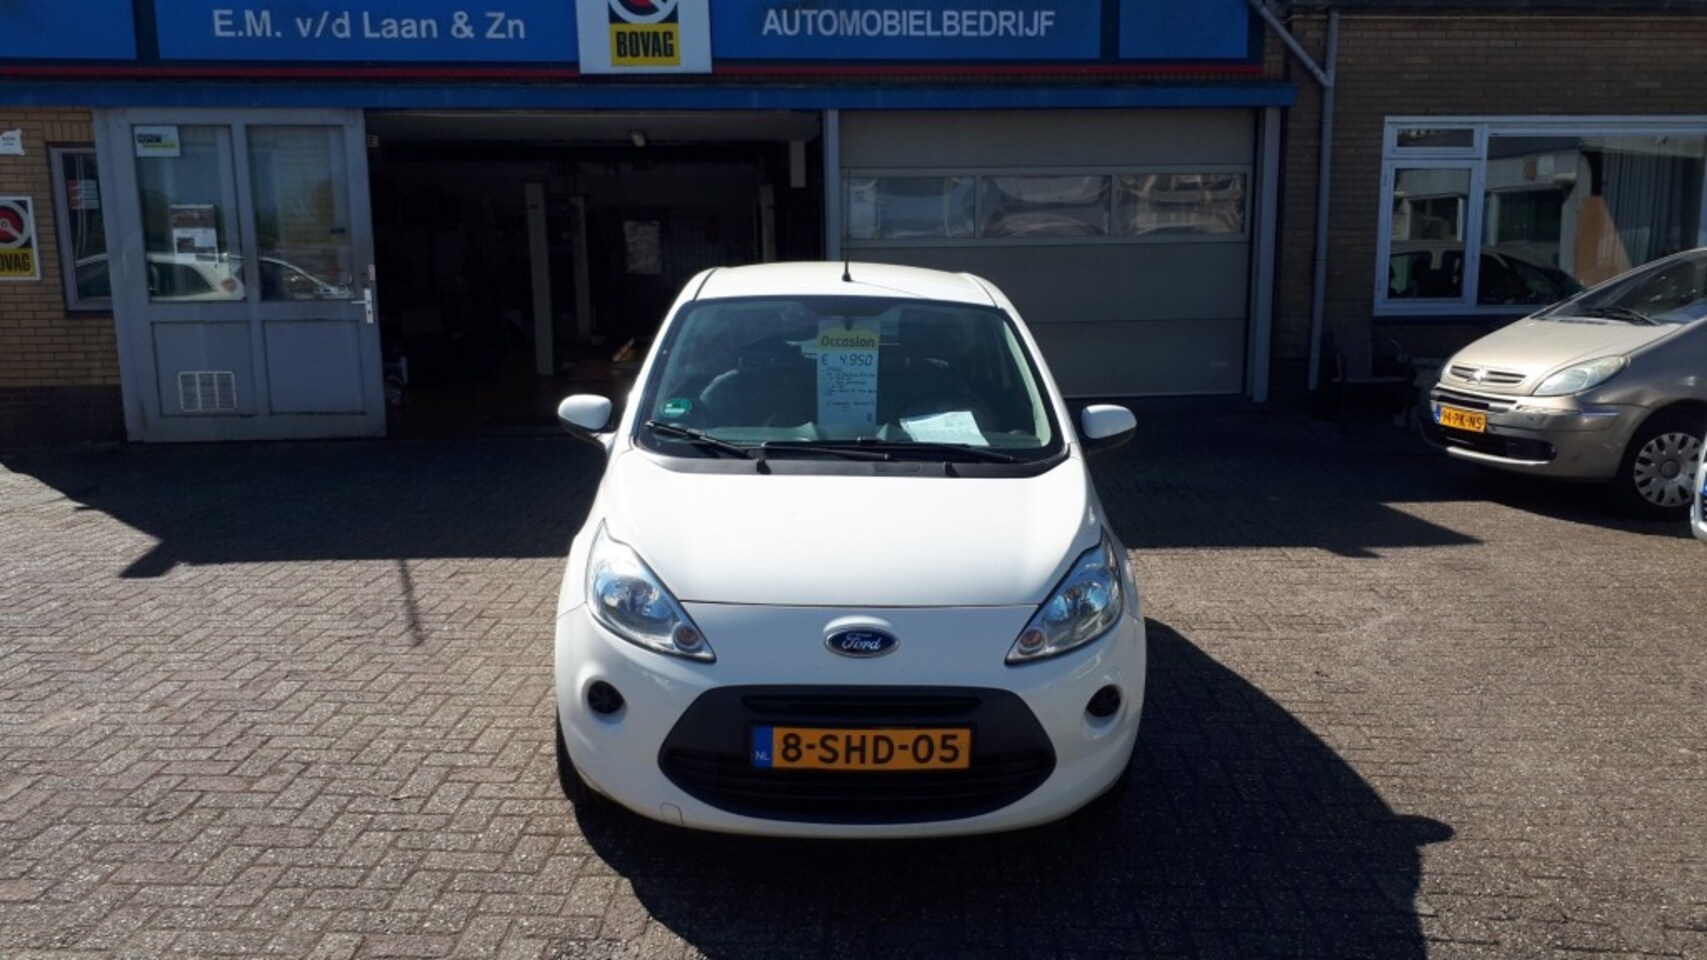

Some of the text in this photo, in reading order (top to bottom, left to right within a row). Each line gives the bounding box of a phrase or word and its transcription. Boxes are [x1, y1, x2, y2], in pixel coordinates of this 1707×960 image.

[213, 9, 525, 39] E.M. v/d Laan & Zn
[762, 9, 1055, 37] AUTOMOBIELBEDRIJF
[616, 31, 674, 58] BOVAG
[821, 336, 875, 348] Occasion
[841, 632, 881, 650] Ford
[755, 750, 770, 761] NL
[781, 732, 960, 765] 8-SHD-05
